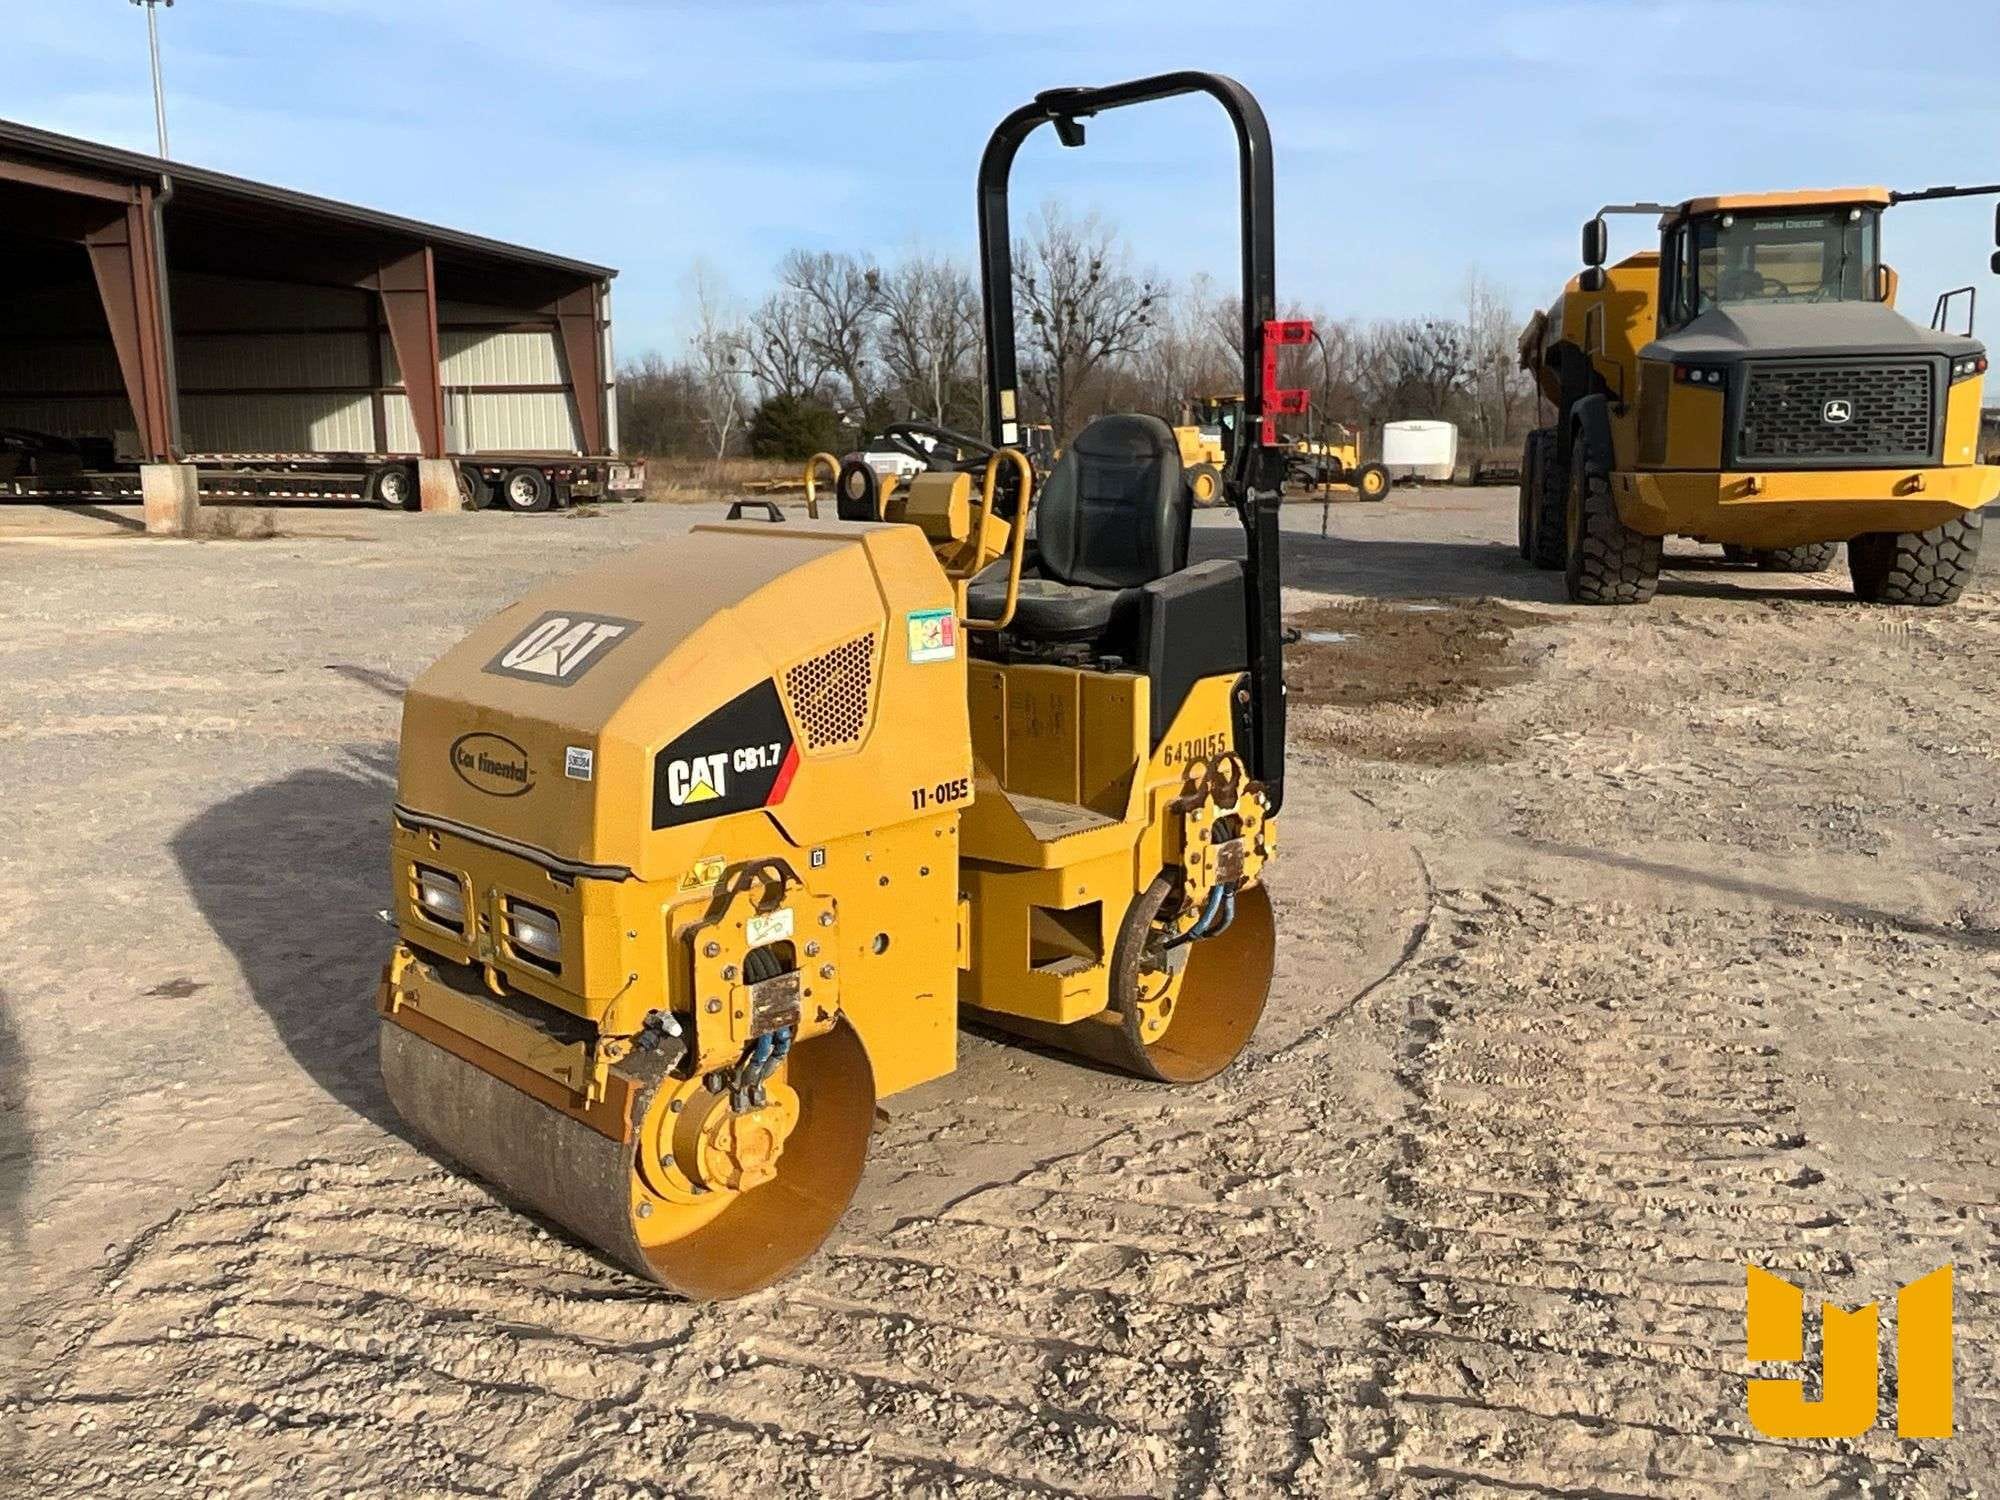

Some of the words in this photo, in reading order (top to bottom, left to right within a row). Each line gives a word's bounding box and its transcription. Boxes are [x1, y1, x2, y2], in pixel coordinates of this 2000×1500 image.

[501, 617, 626, 677] CAT
[667, 752, 729, 806] CAT
[733, 742, 781, 773] CB1.7
[912, 777, 968, 810] 11-0155
